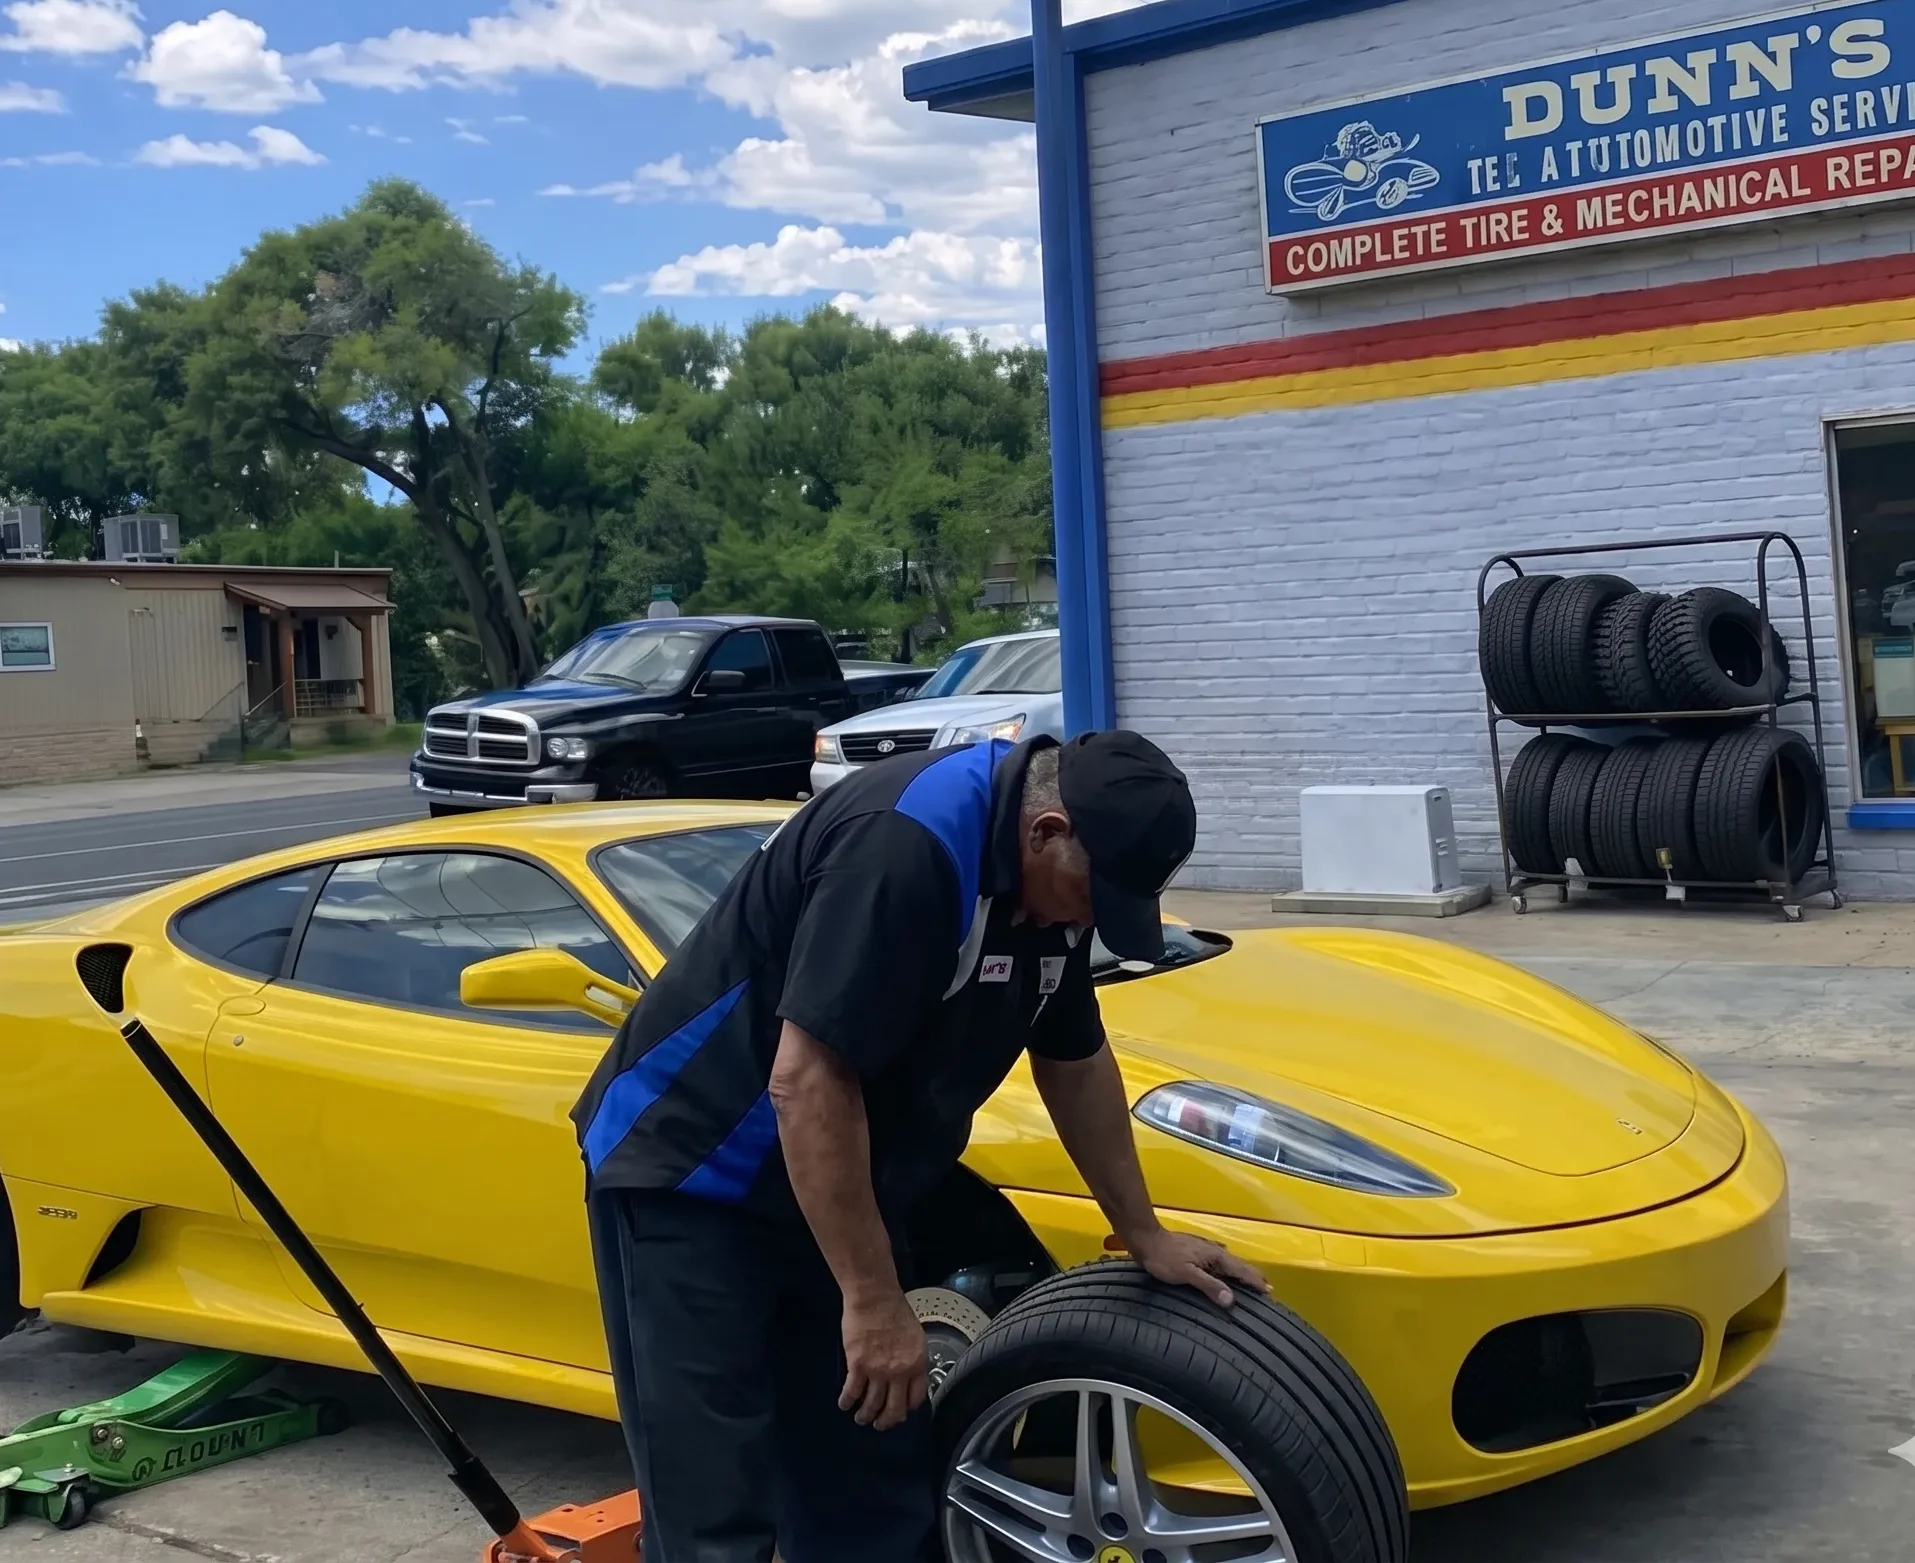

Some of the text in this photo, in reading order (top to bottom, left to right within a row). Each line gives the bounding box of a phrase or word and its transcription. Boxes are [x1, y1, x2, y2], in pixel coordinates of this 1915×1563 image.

[1502, 18, 1891, 142] DUNN'S
[1286, 221, 1447, 276] COMPLETE
[1460, 208, 1529, 248] TIRE
[1541, 203, 1563, 236] &
[1576, 164, 1811, 230] MECHANICAL
